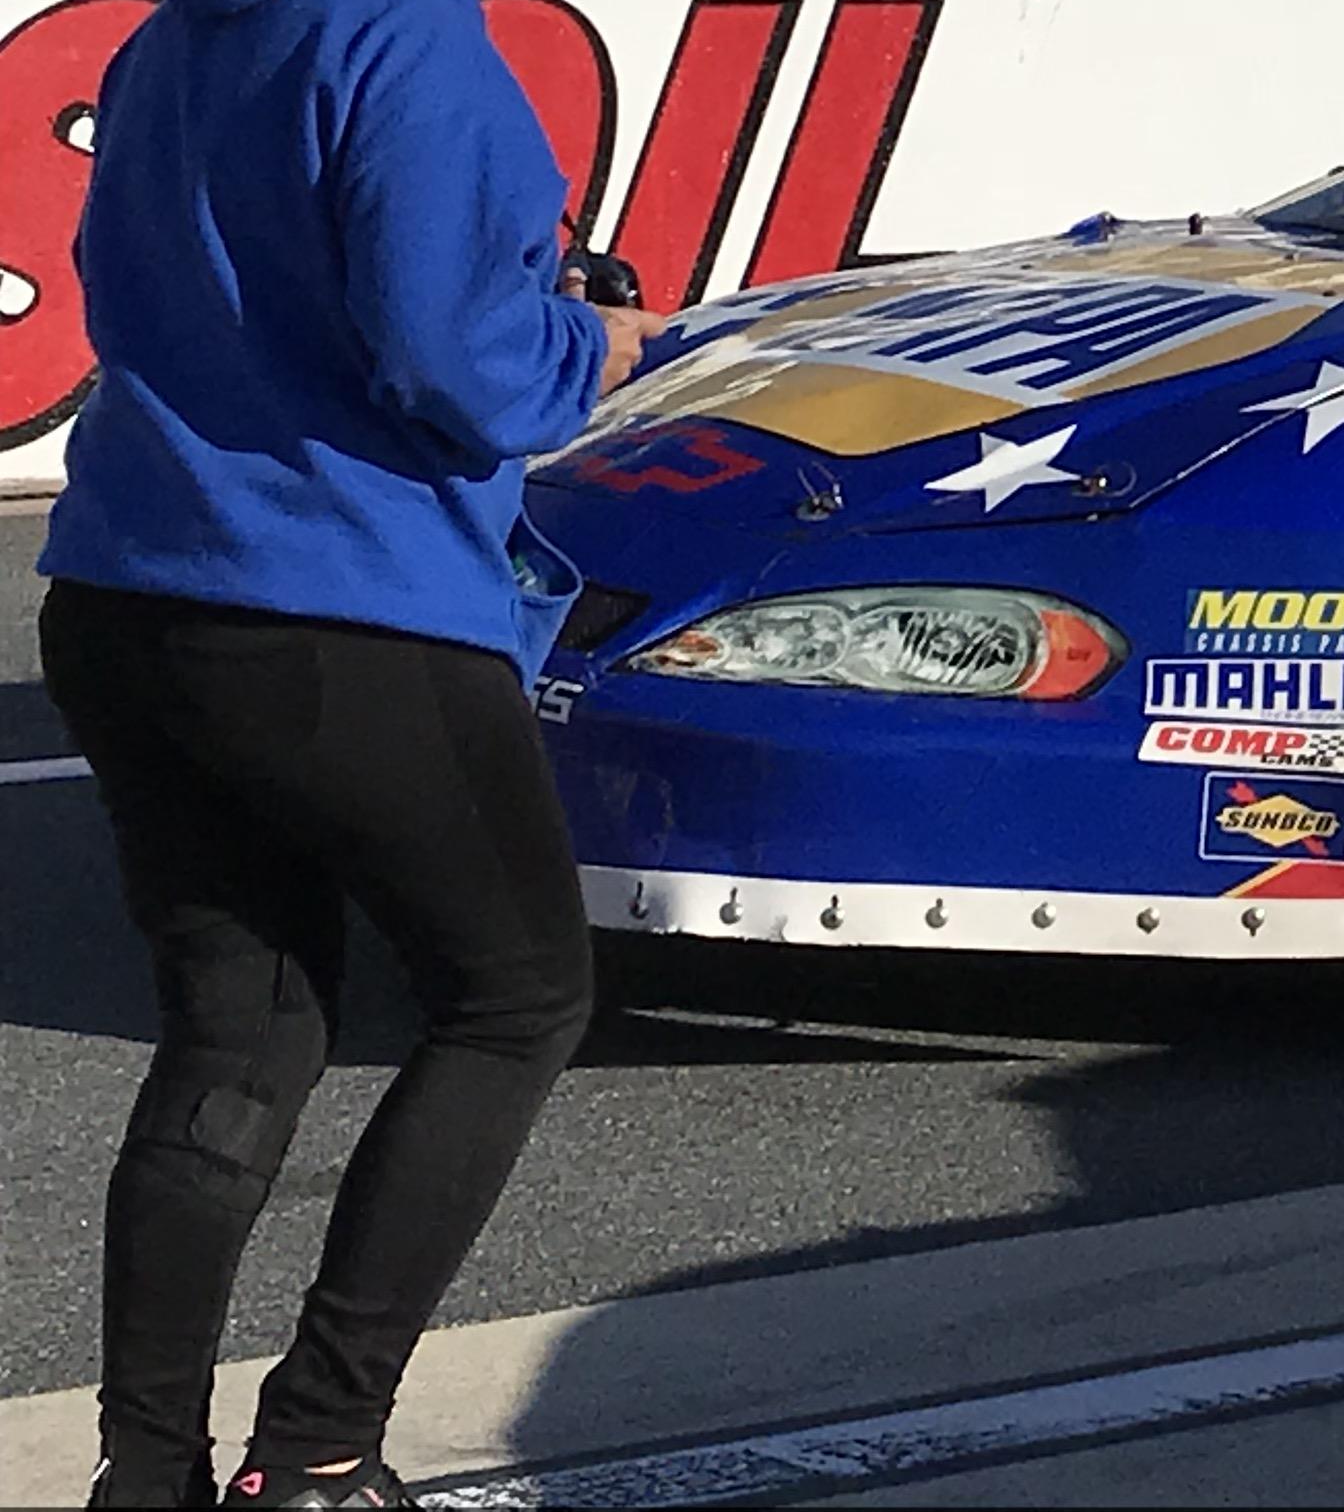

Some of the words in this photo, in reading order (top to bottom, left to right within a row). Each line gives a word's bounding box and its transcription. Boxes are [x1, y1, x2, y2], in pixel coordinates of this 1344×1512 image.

[1197, 633, 1302, 653] CHASSIS
[1155, 726, 1308, 757] COMP
[1260, 753, 1337, 769] CAMS
[1223, 809, 1335, 834] SUNOCO
